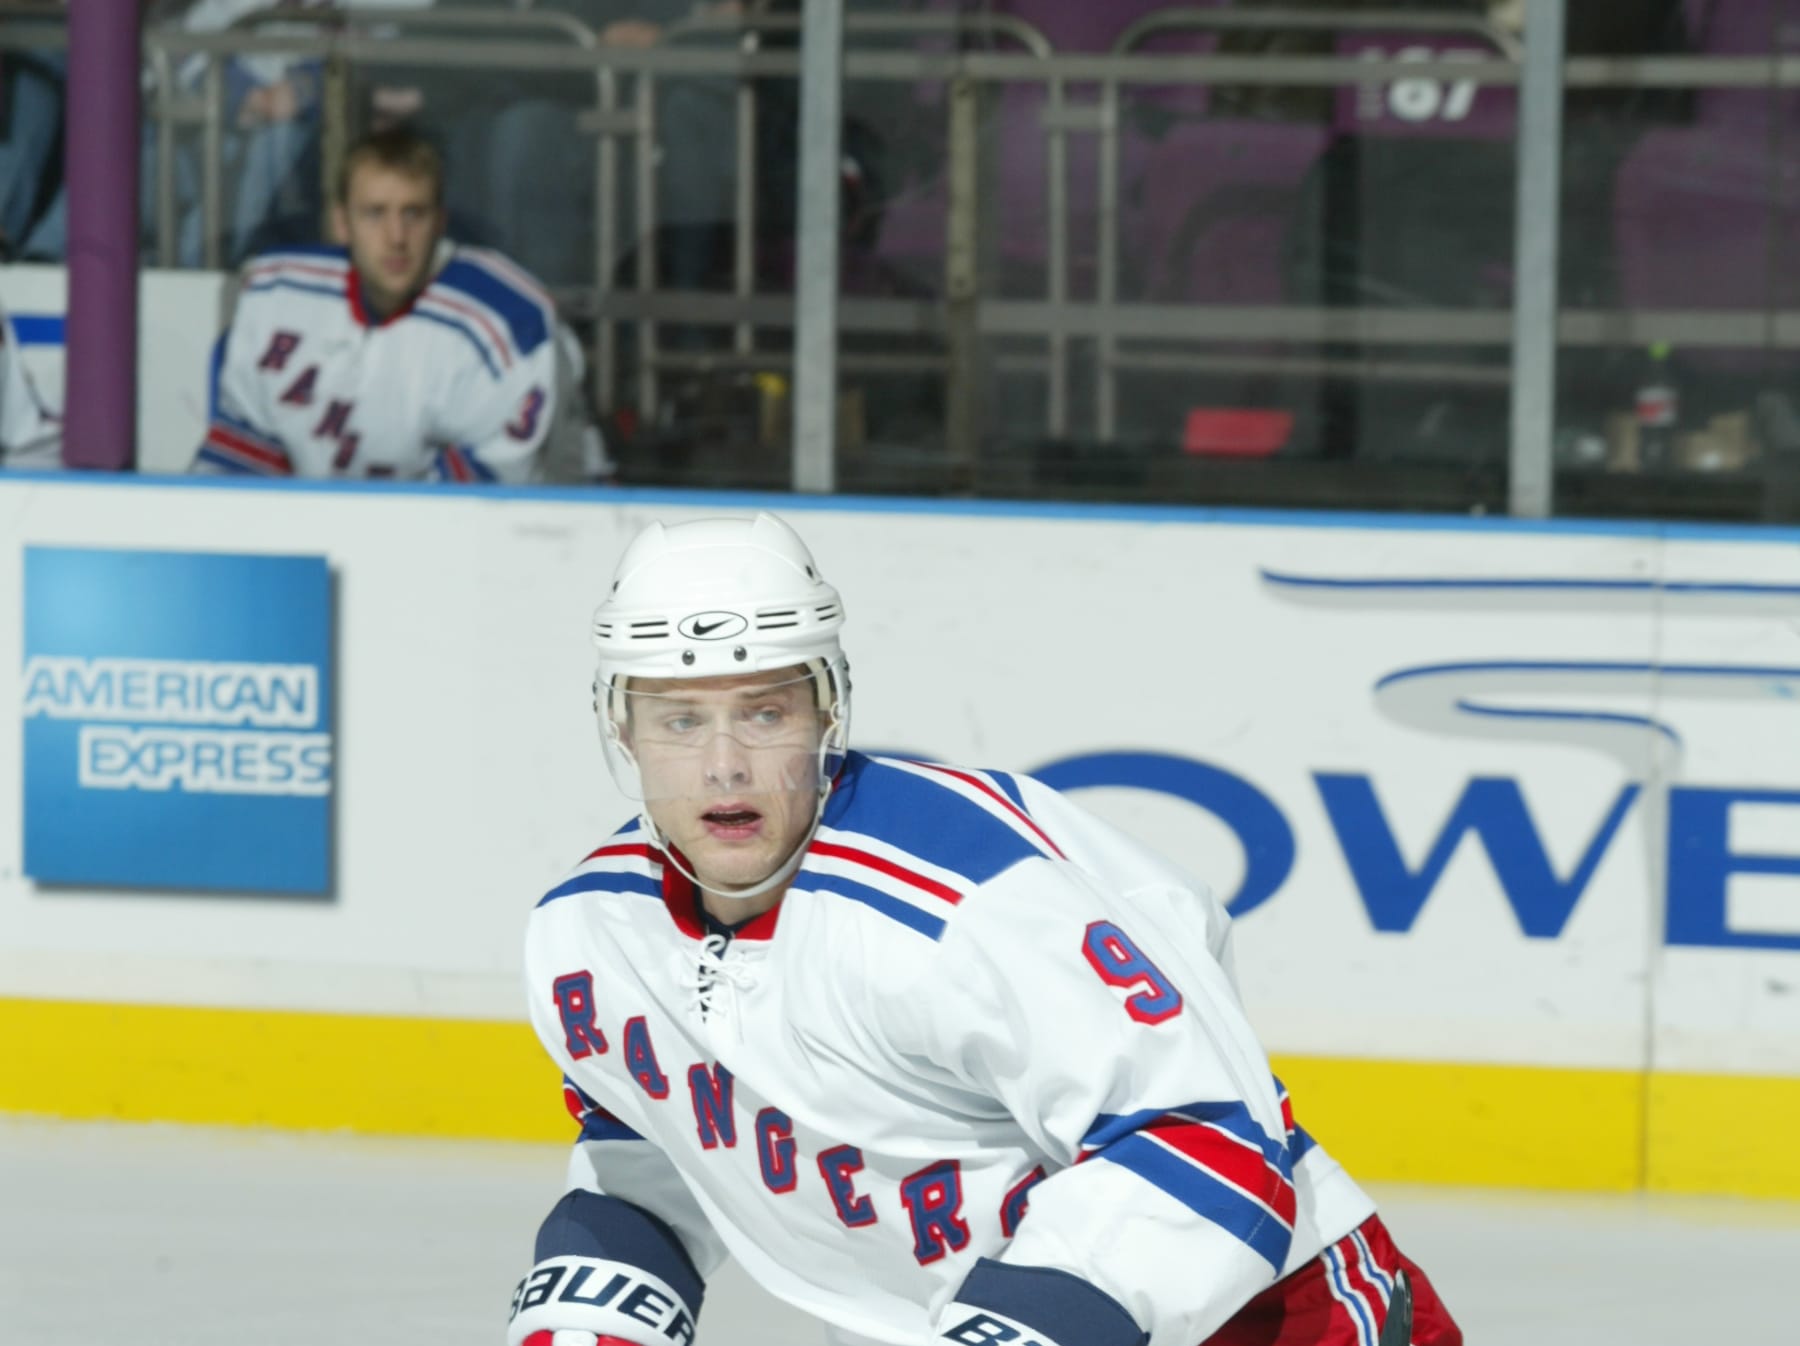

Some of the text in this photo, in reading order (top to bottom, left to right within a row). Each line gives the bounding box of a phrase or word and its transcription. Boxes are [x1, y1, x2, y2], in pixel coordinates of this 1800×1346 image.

[505, 384, 545, 442] 3
[24, 660, 313, 720] AMERICAN
[86, 734, 331, 788] EXPRESS
[868, 747, 1800, 950] OWE
[1082, 919, 1184, 1026] 9
